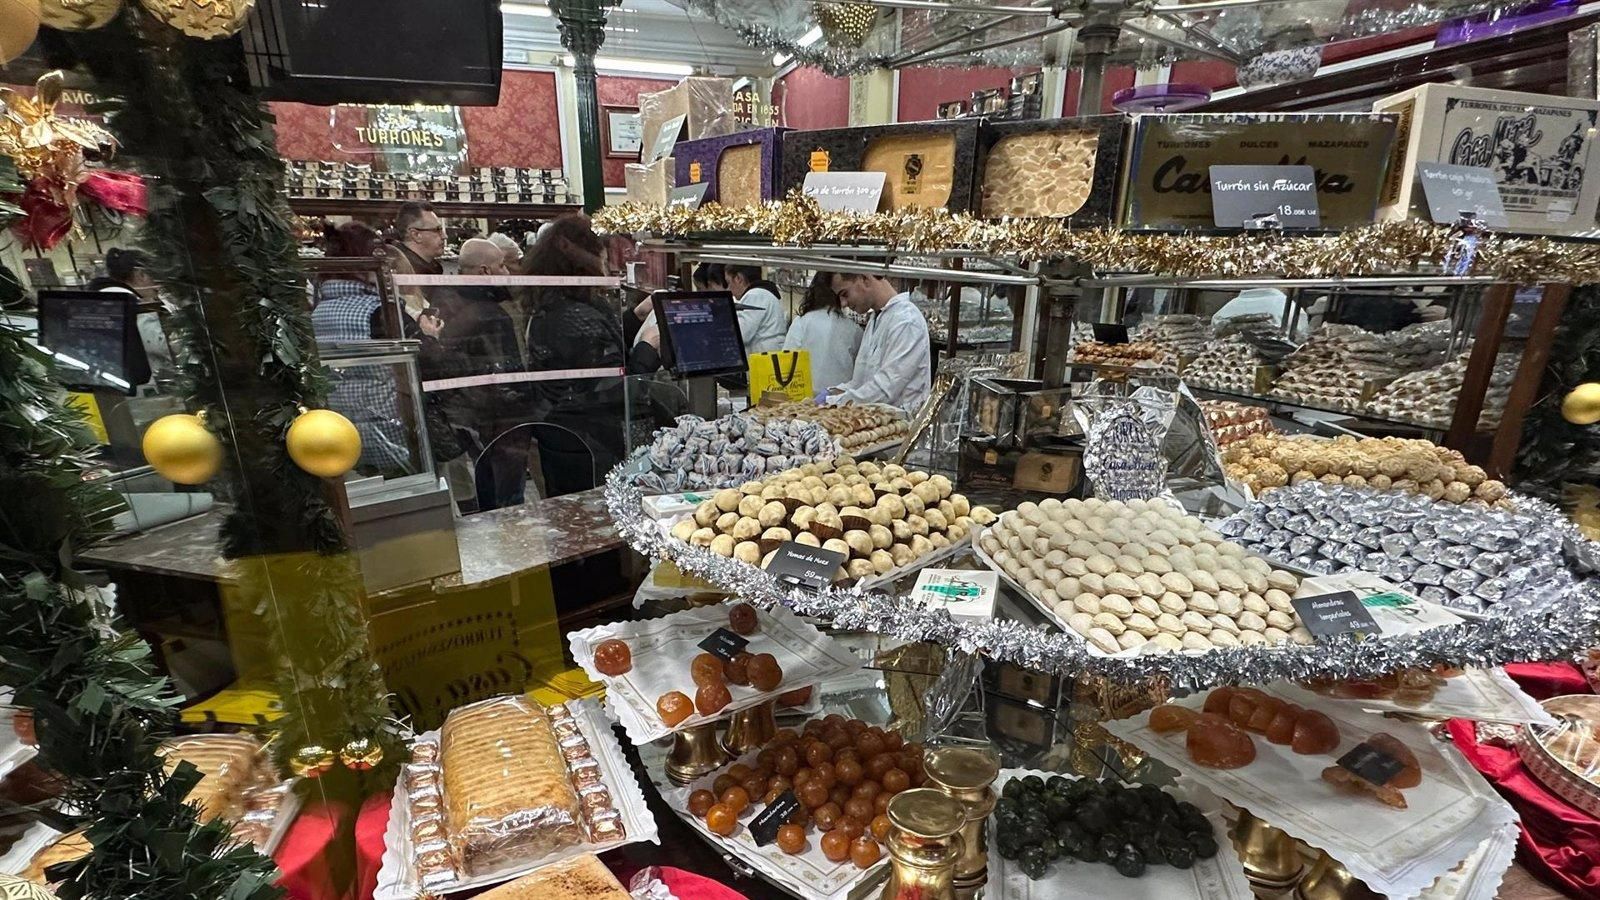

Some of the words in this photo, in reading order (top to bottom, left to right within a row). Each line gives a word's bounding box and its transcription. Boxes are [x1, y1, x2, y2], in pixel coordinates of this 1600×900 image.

[735, 91, 760, 103] ASA
[760, 105, 780, 116] 1855
[355, 127, 443, 147] TURRONES
[1240, 140, 1280, 149] DULCES
[1308, 140, 1369, 149] MAZAPANES
[821, 185, 830, 195] de
[832, 185, 855, 195] Turrón
[1214, 179, 1251, 191] Turrón
[1253, 180, 1270, 191] sin
[1272, 179, 1313, 191] Azúcar
[806, 554, 813, 562] de
